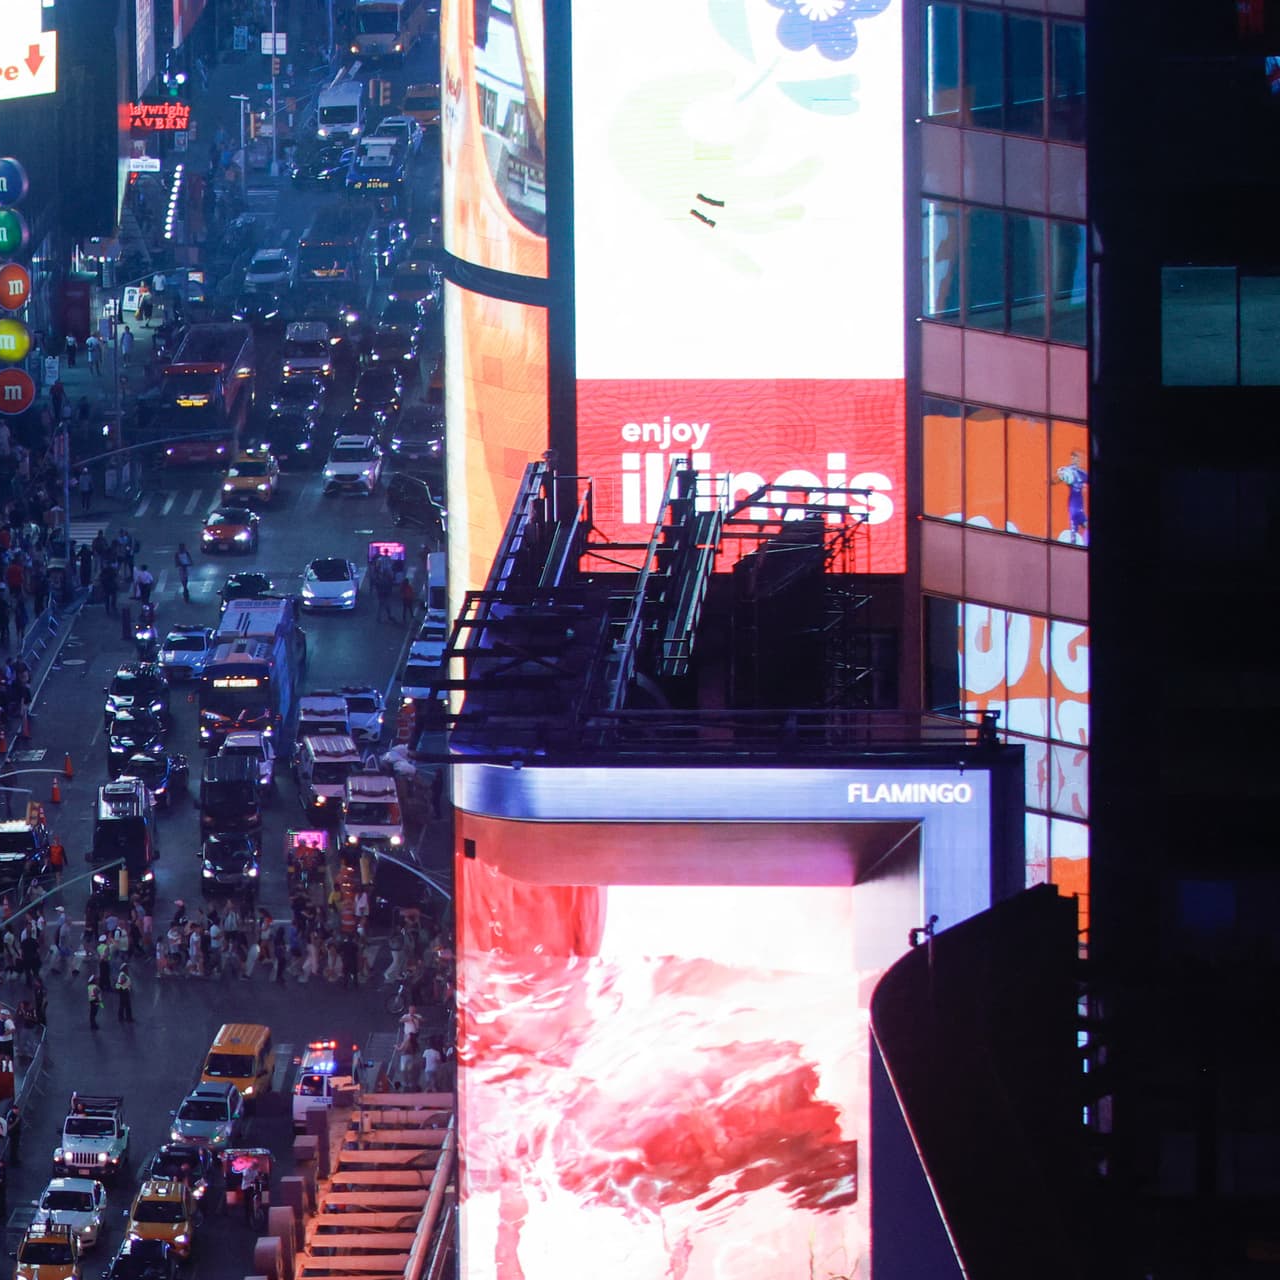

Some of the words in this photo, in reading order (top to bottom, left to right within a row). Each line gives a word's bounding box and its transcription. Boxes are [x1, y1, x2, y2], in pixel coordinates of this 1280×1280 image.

[8, 279, 24, 296] m
[3, 384, 22, 401] m
[621, 415, 711, 450] enjoy
[847, 783, 972, 804] FLAMINGO
